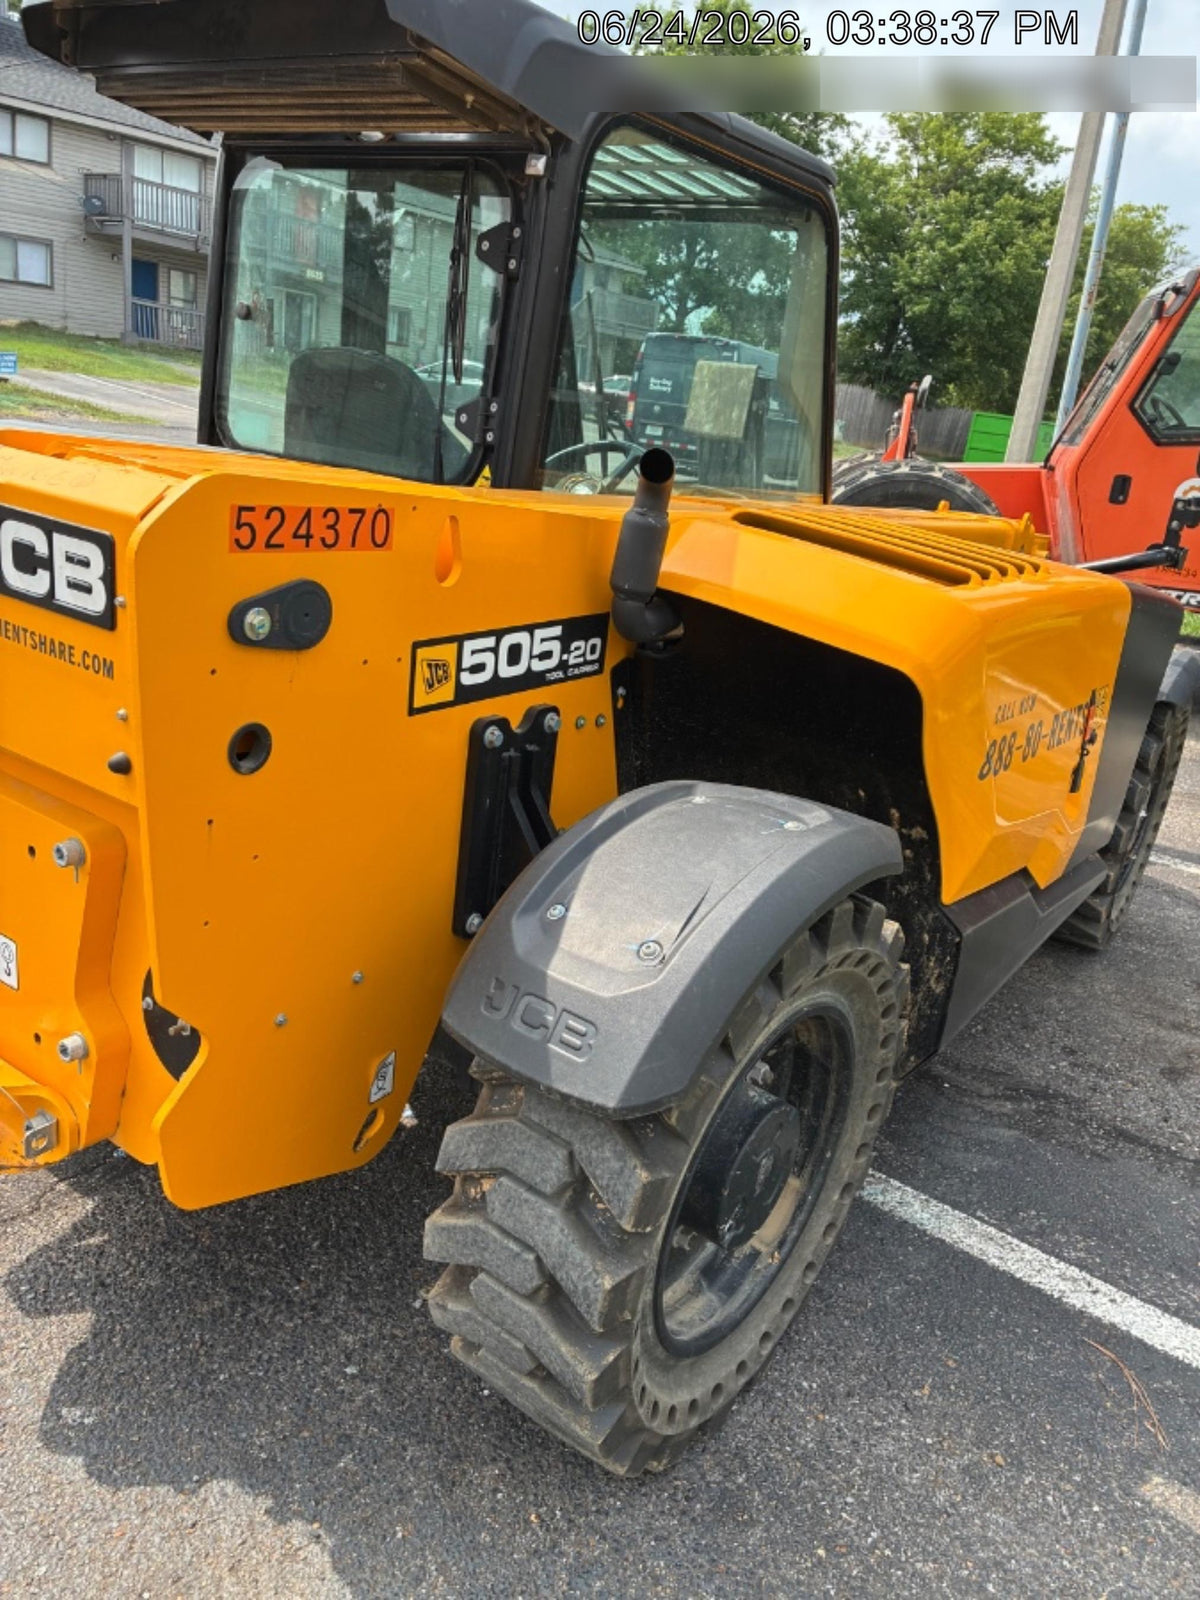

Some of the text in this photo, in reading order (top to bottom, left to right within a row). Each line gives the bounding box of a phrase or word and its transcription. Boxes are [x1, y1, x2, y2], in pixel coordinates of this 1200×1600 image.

[234, 505, 391, 550] 524370
[0, 617, 115, 681] ENTSHARE.COM
[424, 660, 450, 692] JCB
[995, 693, 1038, 725] CALL NOW
[481, 976, 599, 1063] JCB
